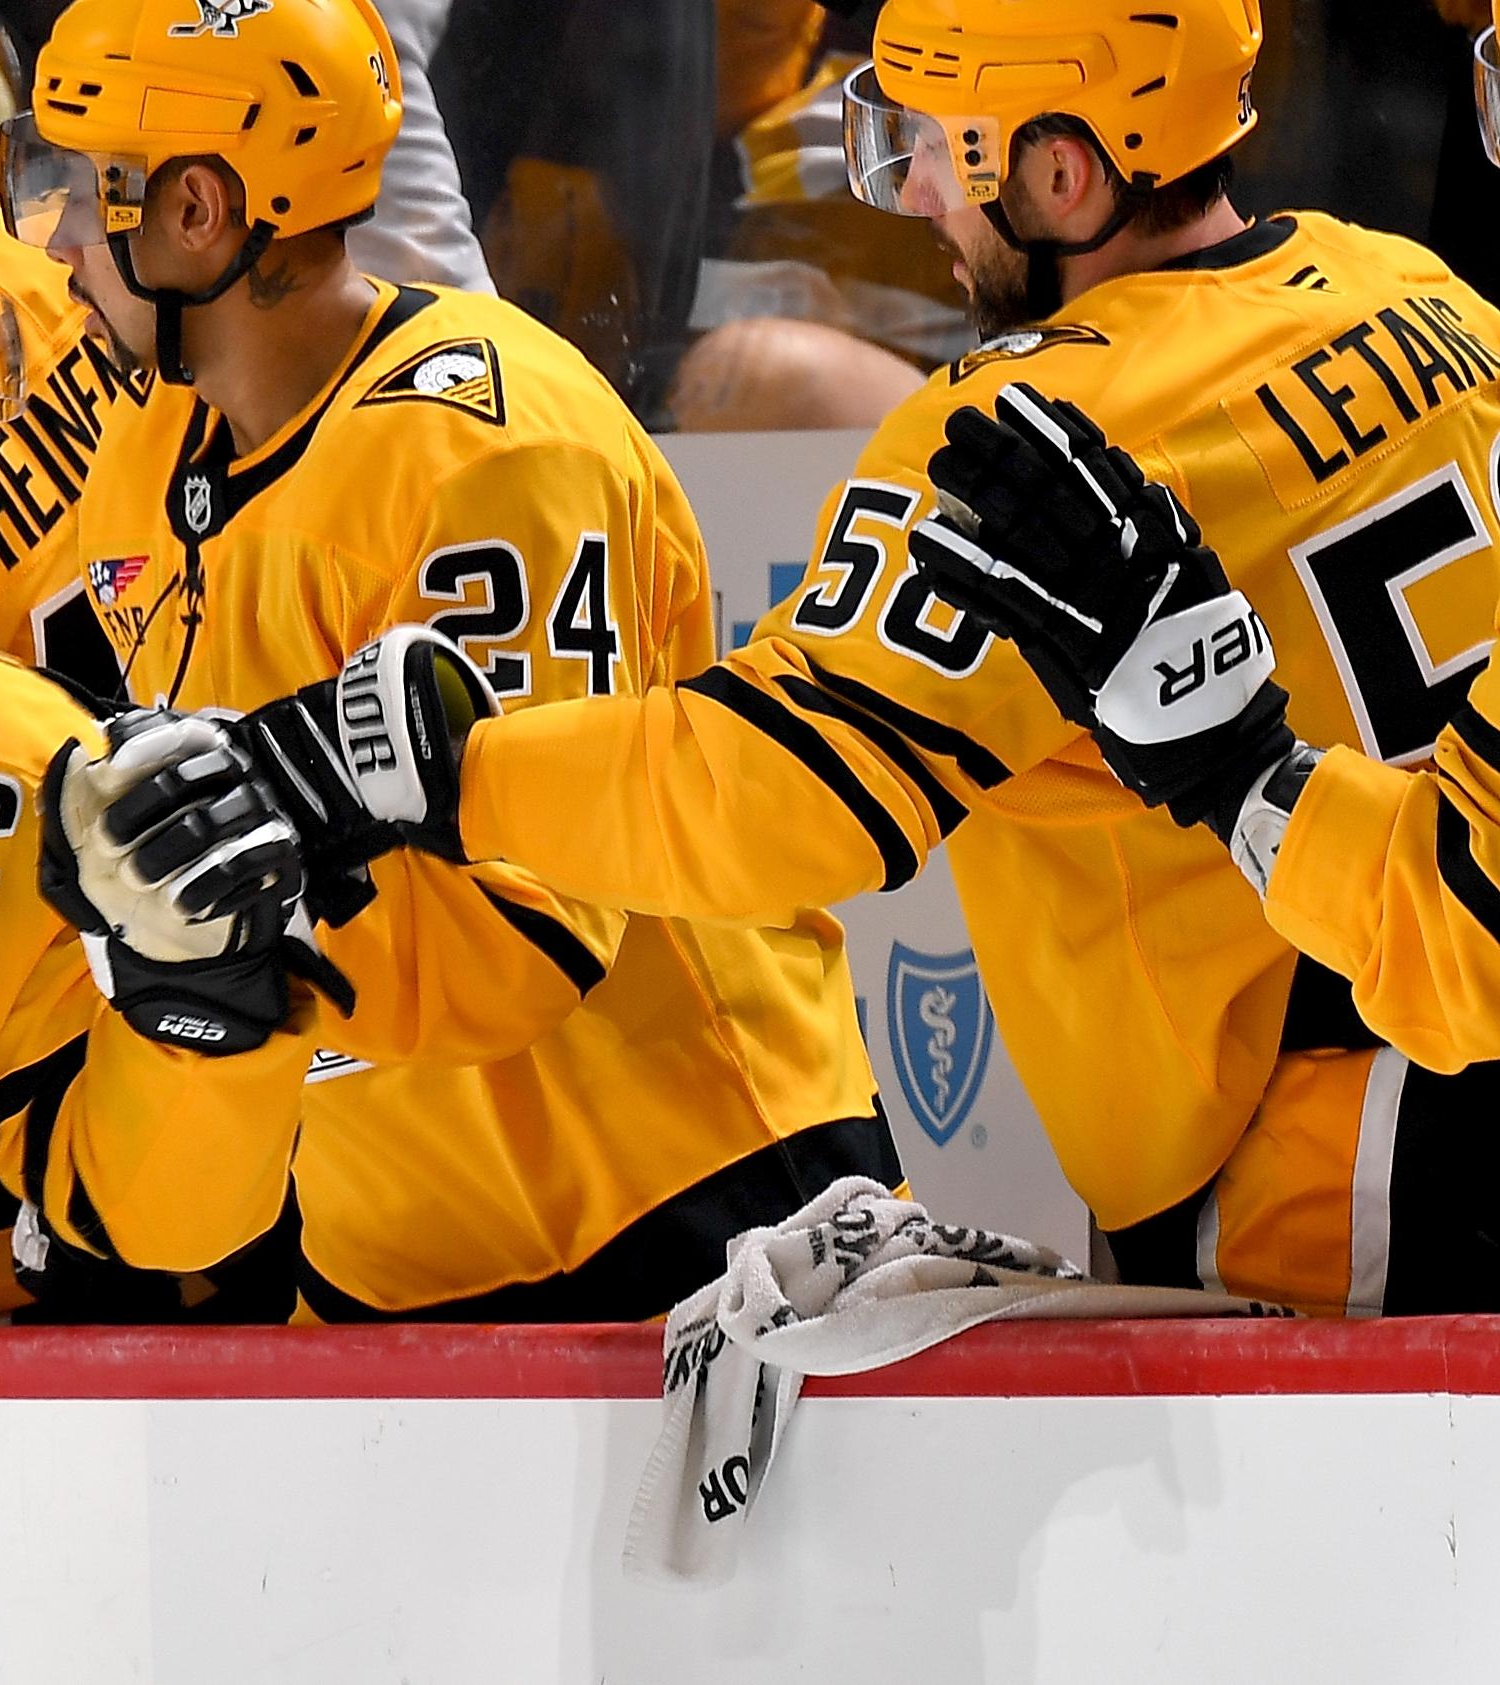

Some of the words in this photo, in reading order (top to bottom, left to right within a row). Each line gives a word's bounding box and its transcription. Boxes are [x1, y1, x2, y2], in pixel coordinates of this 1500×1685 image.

[420, 532, 620, 697] 24
[1288, 440, 1500, 765] 5
[157, 1019, 228, 1041] CCM
